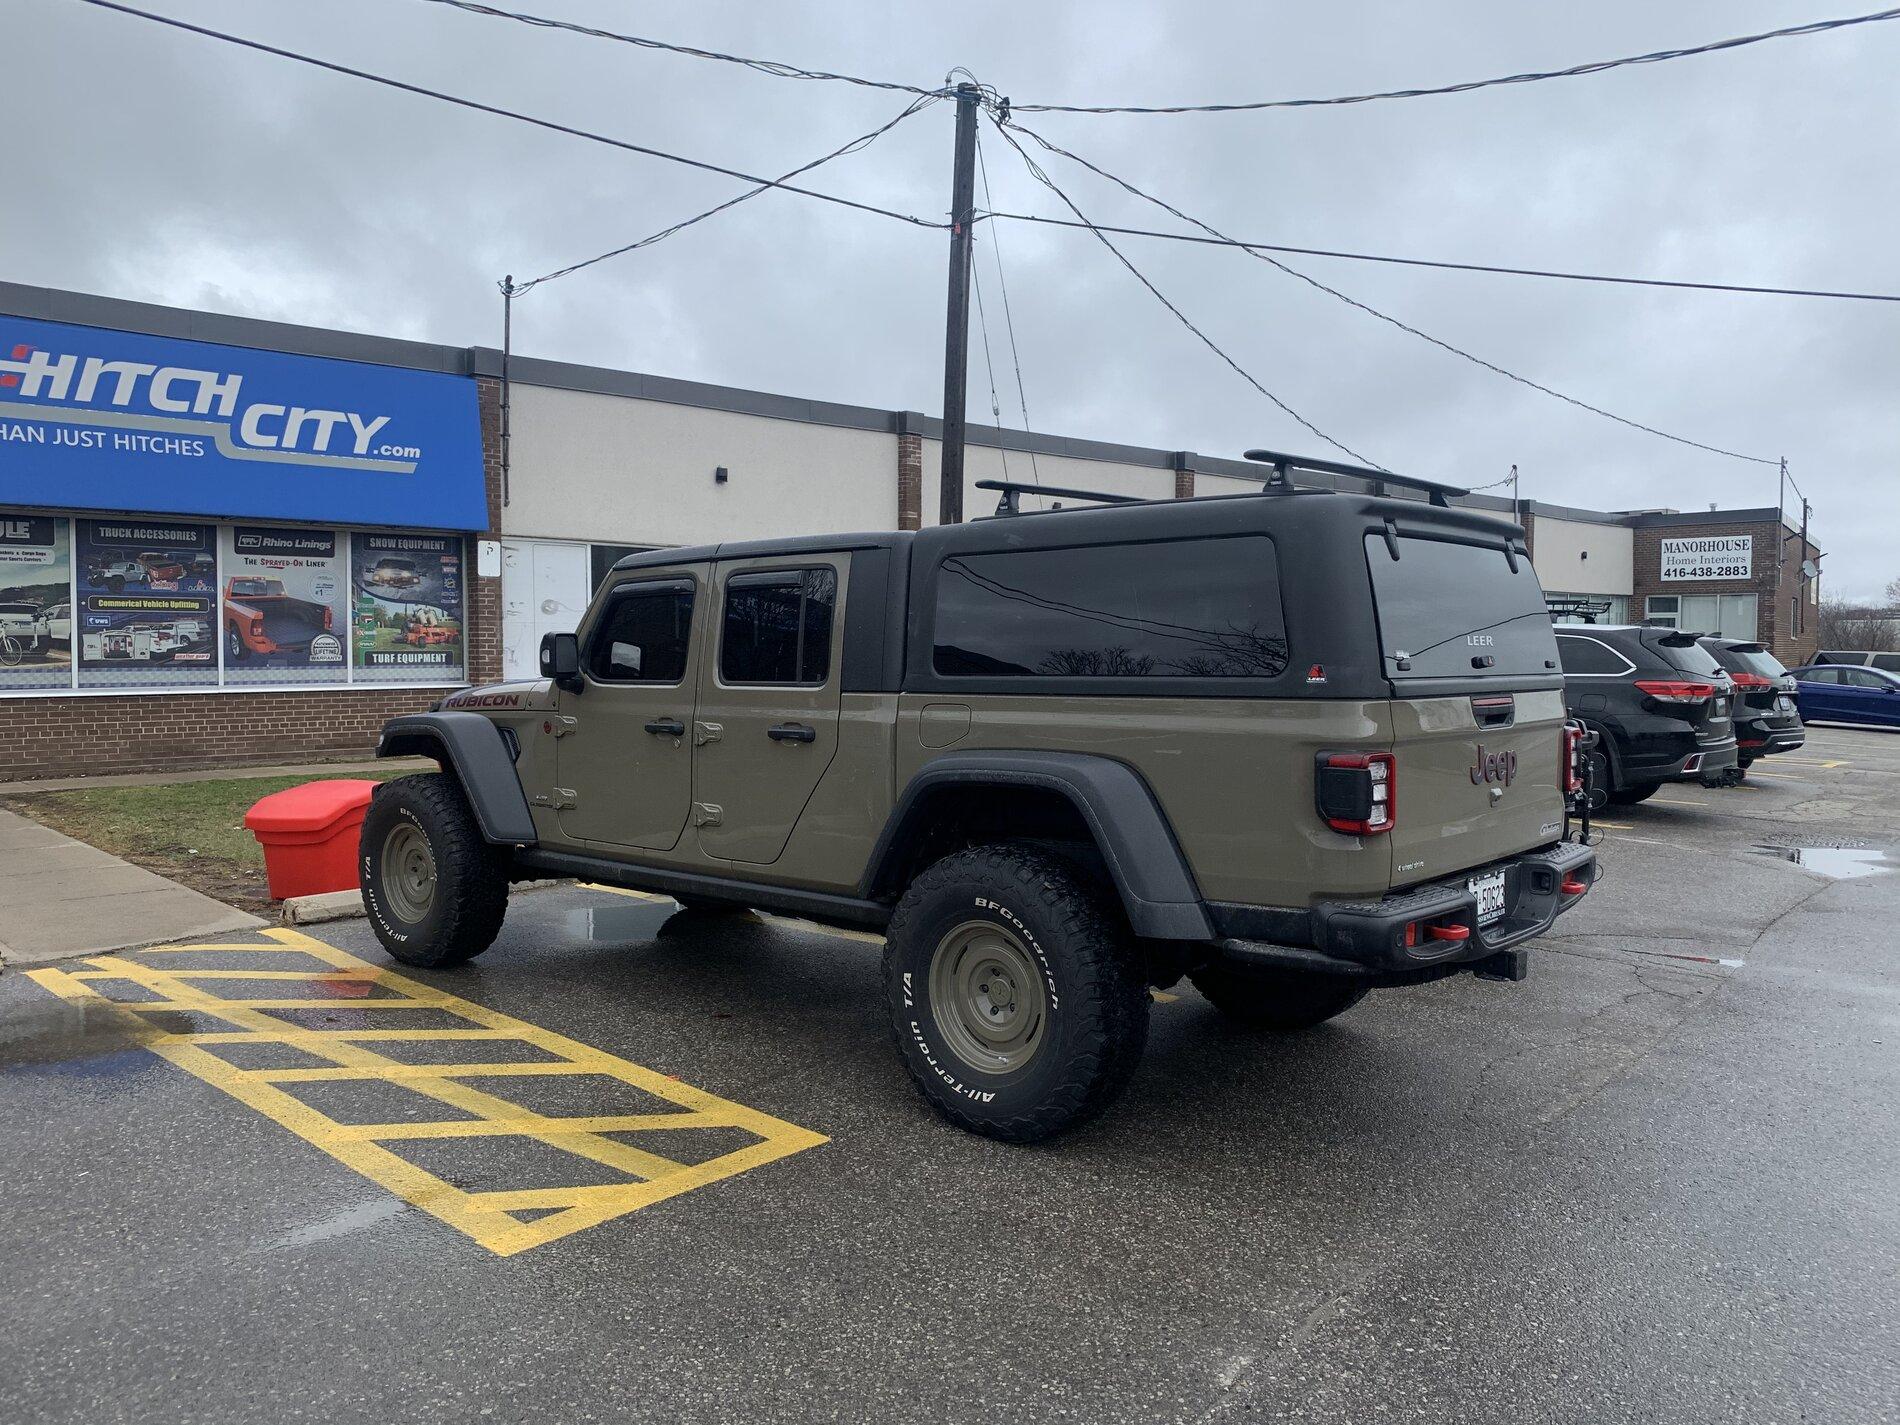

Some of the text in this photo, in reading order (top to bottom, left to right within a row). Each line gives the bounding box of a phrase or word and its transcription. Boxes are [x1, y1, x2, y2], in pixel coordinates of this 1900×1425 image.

[20, 351, 243, 416] HITCH
[53, 428, 107, 448] JUST
[114, 433, 205, 457] HITCHES
[99, 527, 197, 541] TRUCK ACCESSORIES
[262, 537, 332, 550] Rhino Linings
[369, 537, 446, 550] SNOW EQUIPMENT
[1663, 539, 1750, 553] MANORHOUSE
[306, 559, 326, 567] LINER
[1666, 554, 1747, 565] Home Interiors
[1664, 565, 1748, 577] 416-438-2883
[143, 600, 170, 608] Vehicle
[1467, 635, 1494, 646] LEER
[372, 653, 447, 664] TURF EQUIPMENT
[446, 694, 520, 708] RUBICON
[1470, 744, 1518, 787] Jeep
[974, 897, 1058, 1009] BFGoodrich
[903, 972, 996, 1103] All-Terrain T/A
